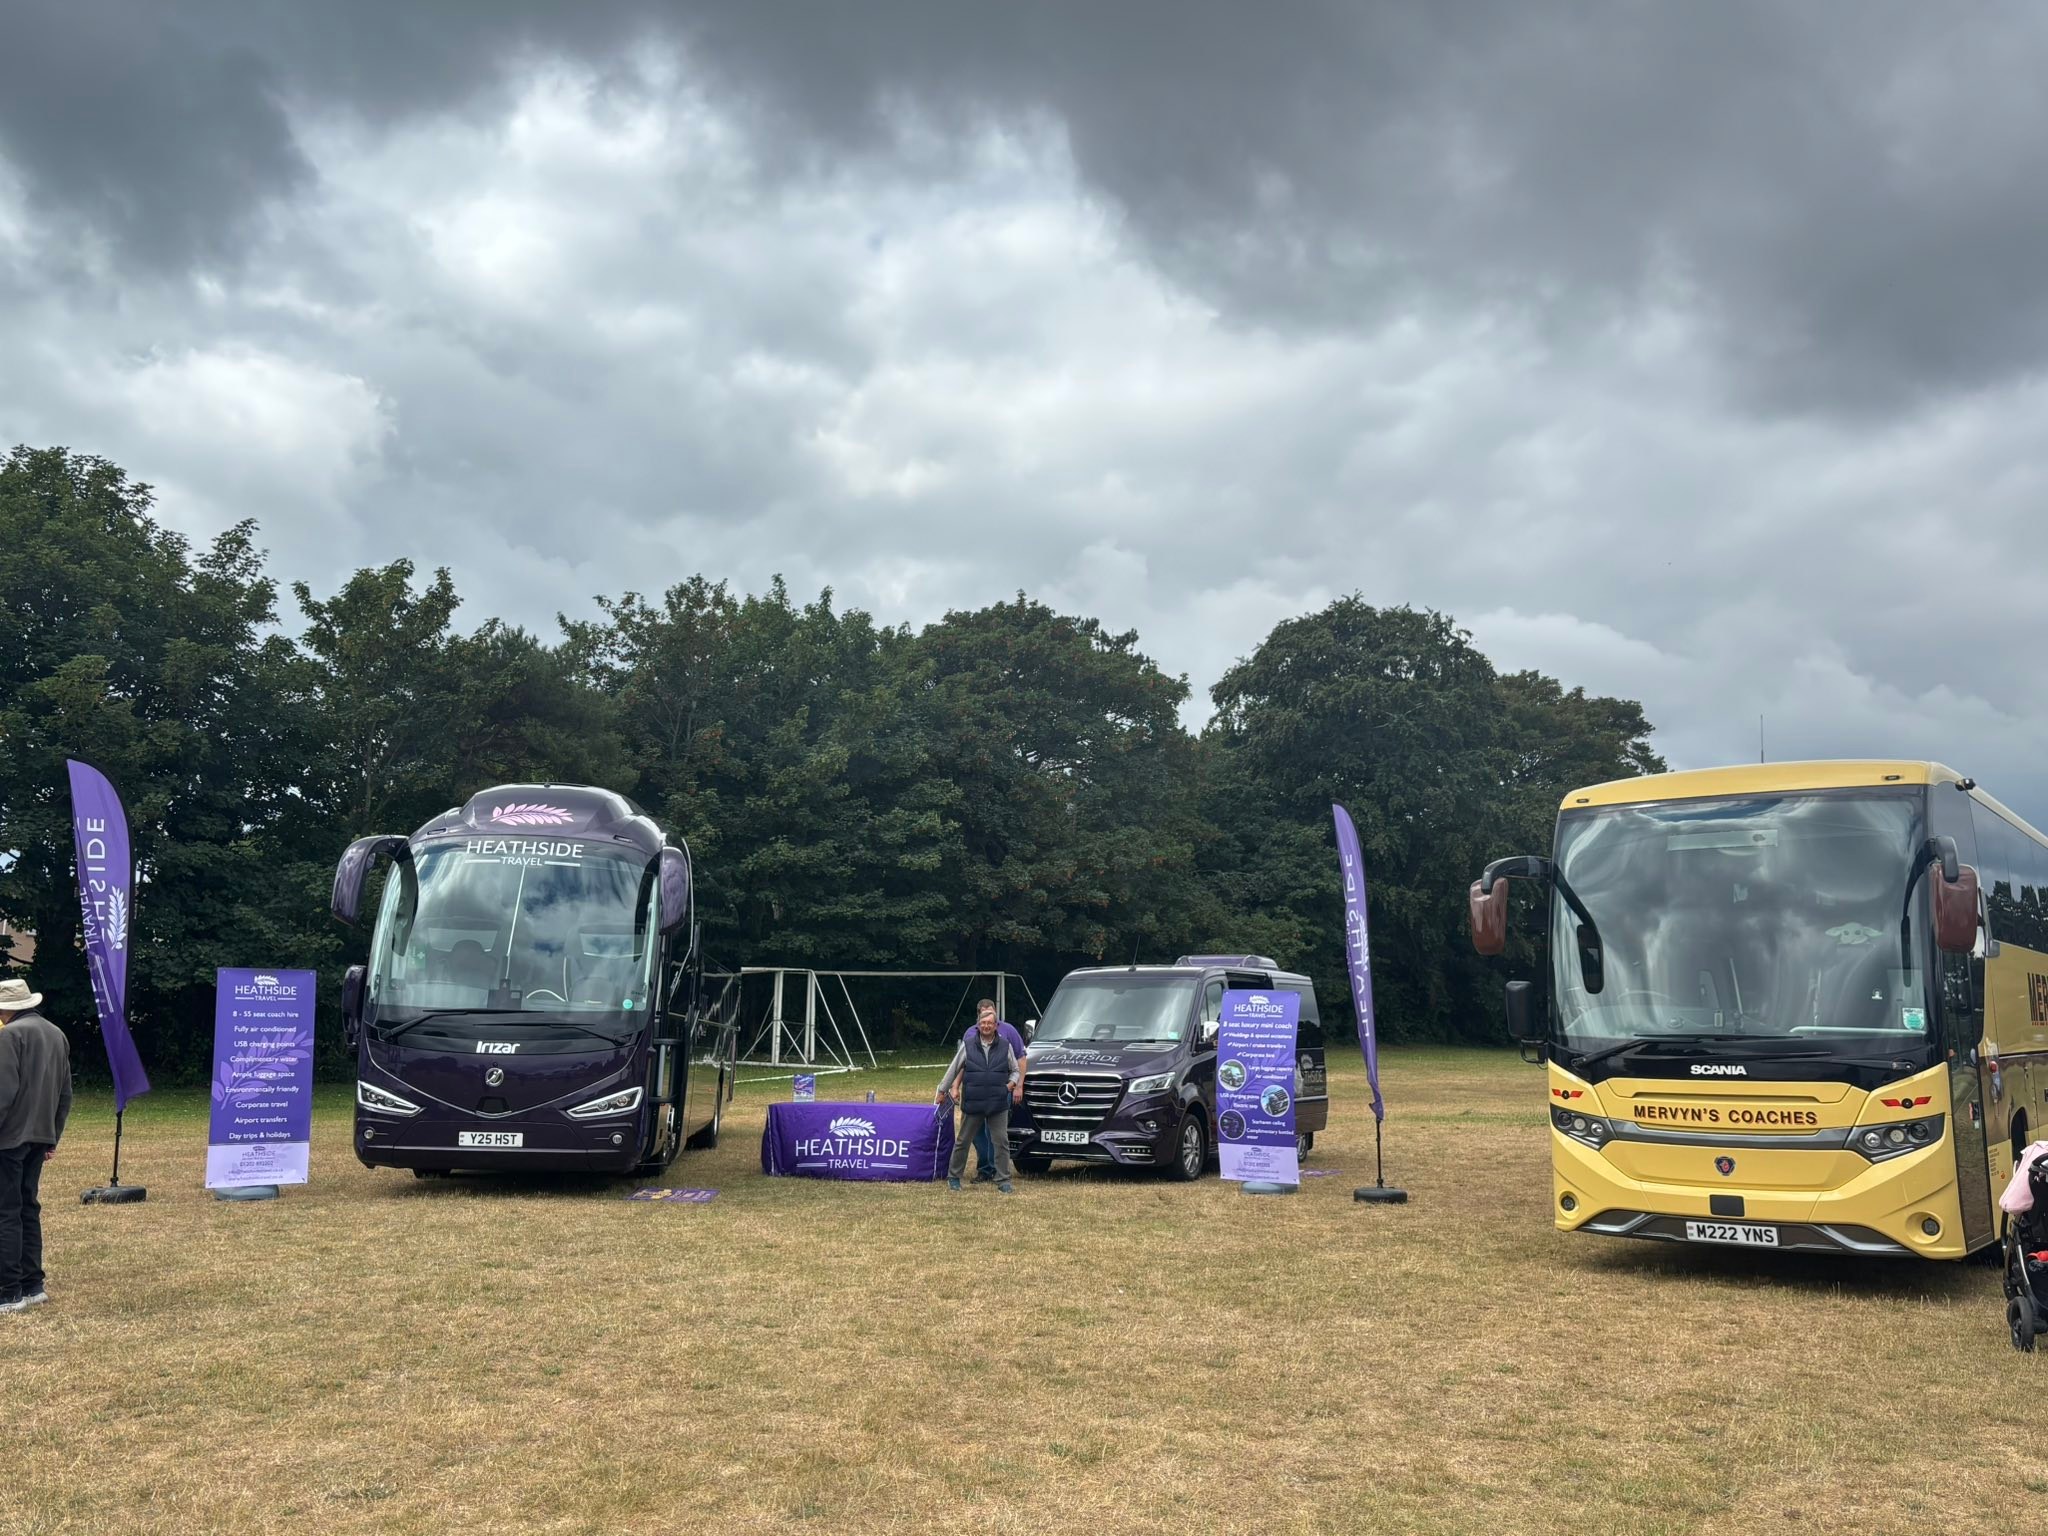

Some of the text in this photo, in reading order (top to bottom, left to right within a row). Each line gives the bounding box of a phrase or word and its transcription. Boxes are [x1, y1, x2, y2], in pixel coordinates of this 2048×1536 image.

[466, 840, 585, 858] HEATHSIDE
[501, 856, 543, 866] TRAVEL
[234, 985, 297, 995] HEATHSIDE
[1234, 1004, 1284, 1013] HEATHSIDE
[249, 1041, 275, 1049] charging
[276, 1040, 296, 1048] points
[476, 1041, 520, 1054] Irizar
[1039, 1054, 1122, 1063] HEATHSIDE
[1690, 1064, 1747, 1076] SCANIA
[225, 1086, 275, 1094] Environmentally
[235, 1101, 269, 1109] Corporate
[1634, 1105, 1818, 1125] MERVYN'S COACHES
[229, 1132, 242, 1140] Day
[470, 1133, 517, 1144] Y25 HST
[1044, 1132, 1085, 1142] CA25 FGP
[795, 1139, 910, 1157] HEATHSIDE
[828, 1159, 868, 1169] TRAVEL
[1697, 1224, 1774, 1243] M222 YNS
